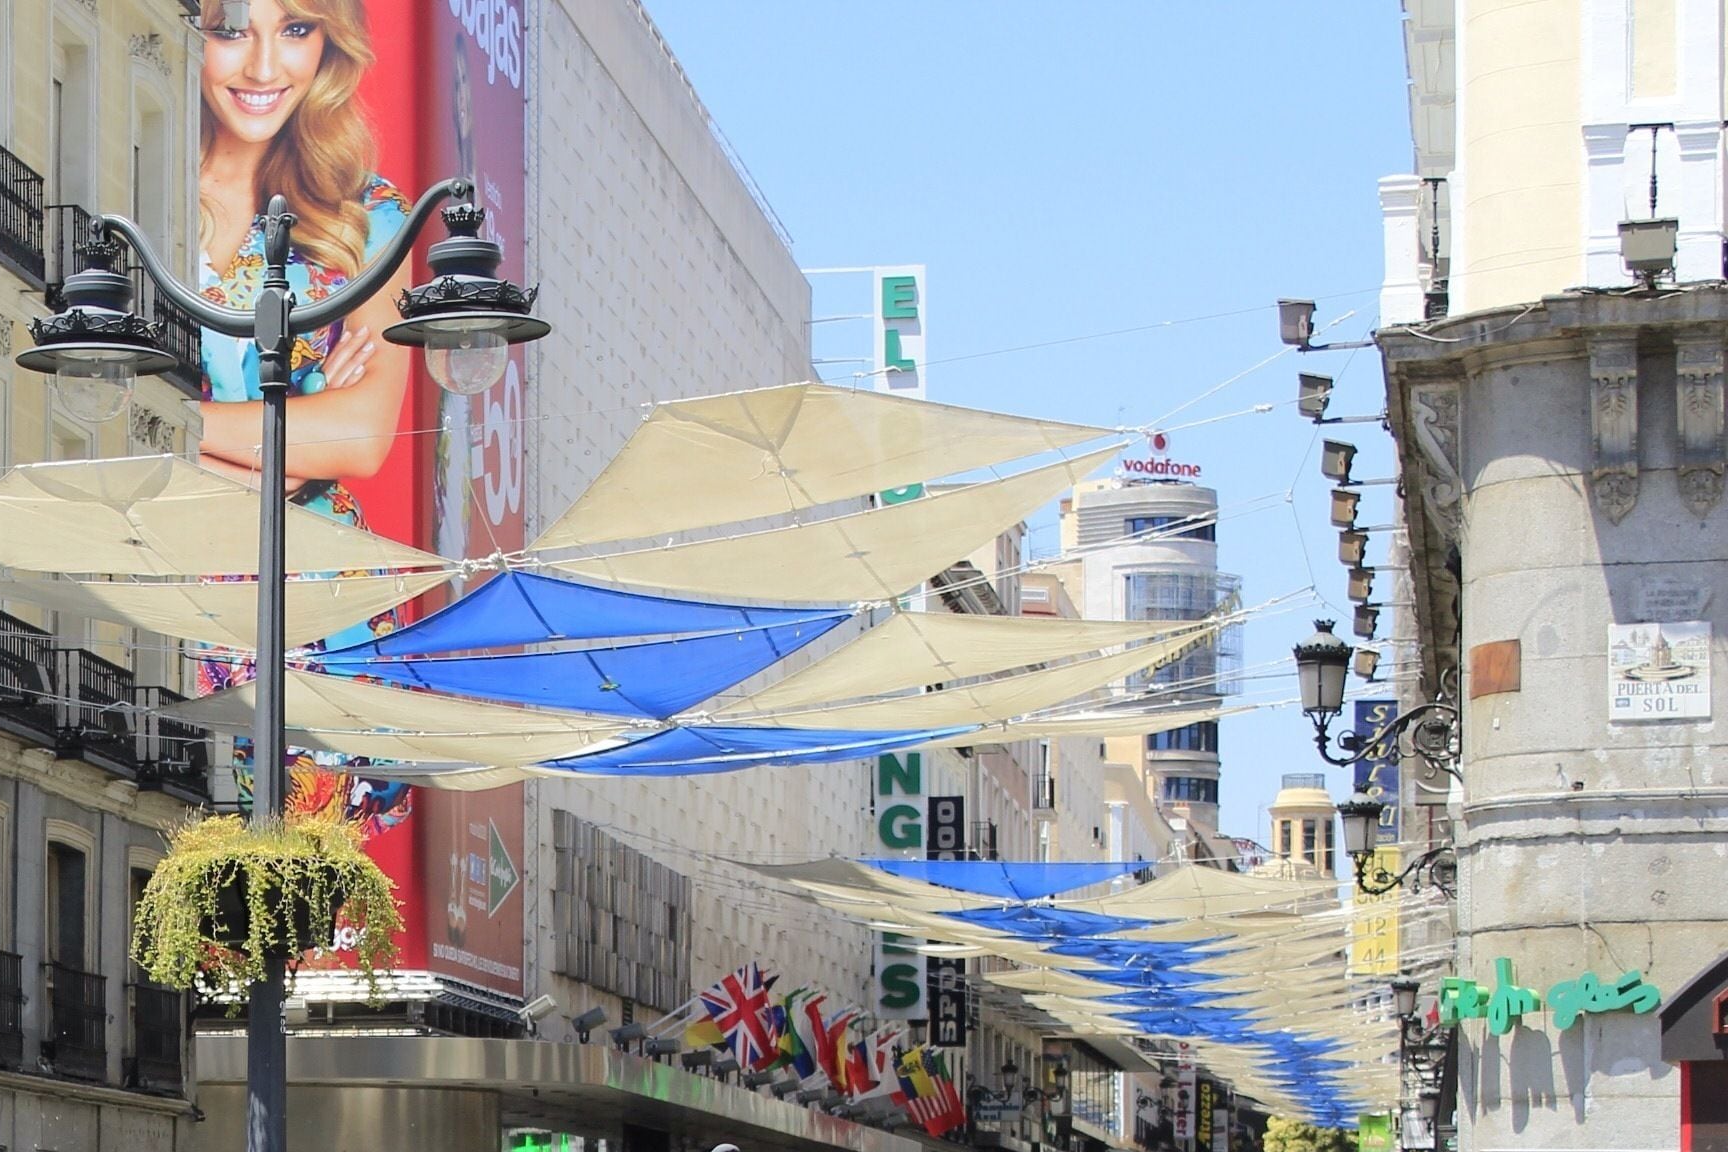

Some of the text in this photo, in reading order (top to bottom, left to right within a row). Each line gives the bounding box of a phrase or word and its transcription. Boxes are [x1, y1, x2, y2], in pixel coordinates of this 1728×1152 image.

[882, 276, 918, 371] EL
[1123, 458, 1201, 477] vodafone
[1617, 682, 1702, 696] PUERTA DEL
[1643, 698, 1679, 712] SOL
